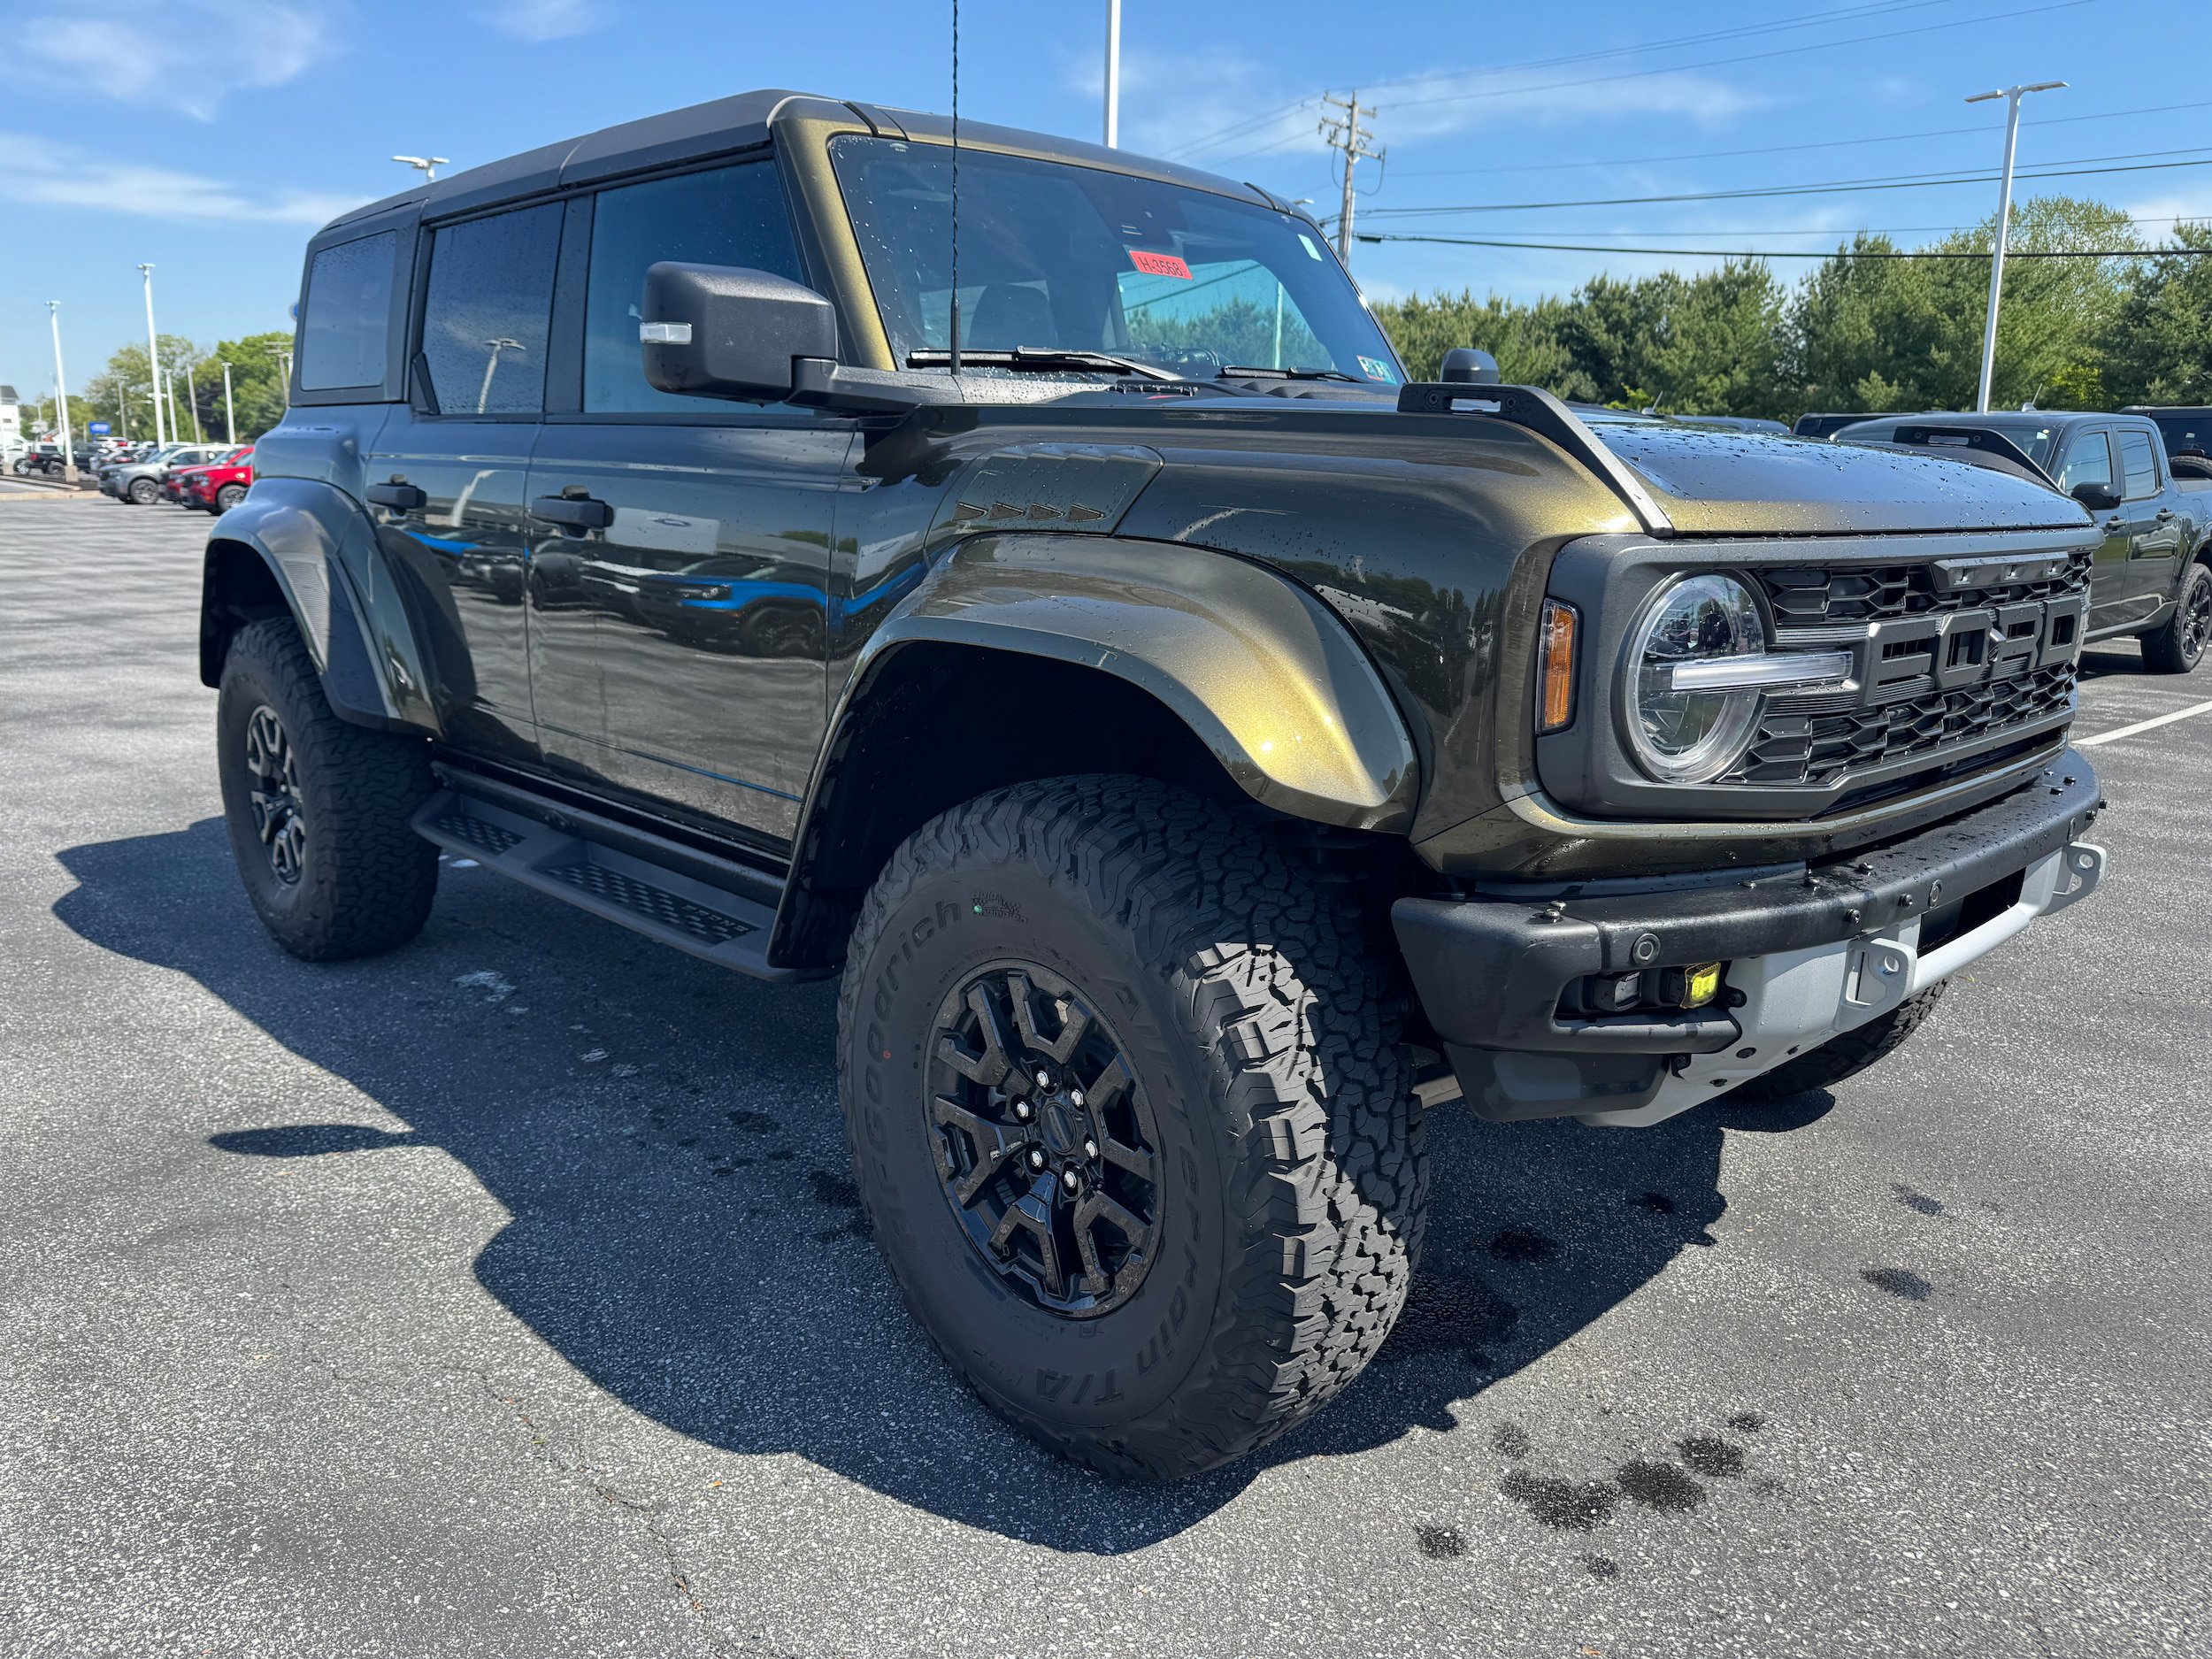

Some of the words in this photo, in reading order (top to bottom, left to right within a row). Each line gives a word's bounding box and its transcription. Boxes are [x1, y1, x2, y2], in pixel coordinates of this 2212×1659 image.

[1138, 256, 1184, 276] H-3568
[1863, 593, 2081, 707] FORD
[1035, 1367, 1125, 1406] T/A
